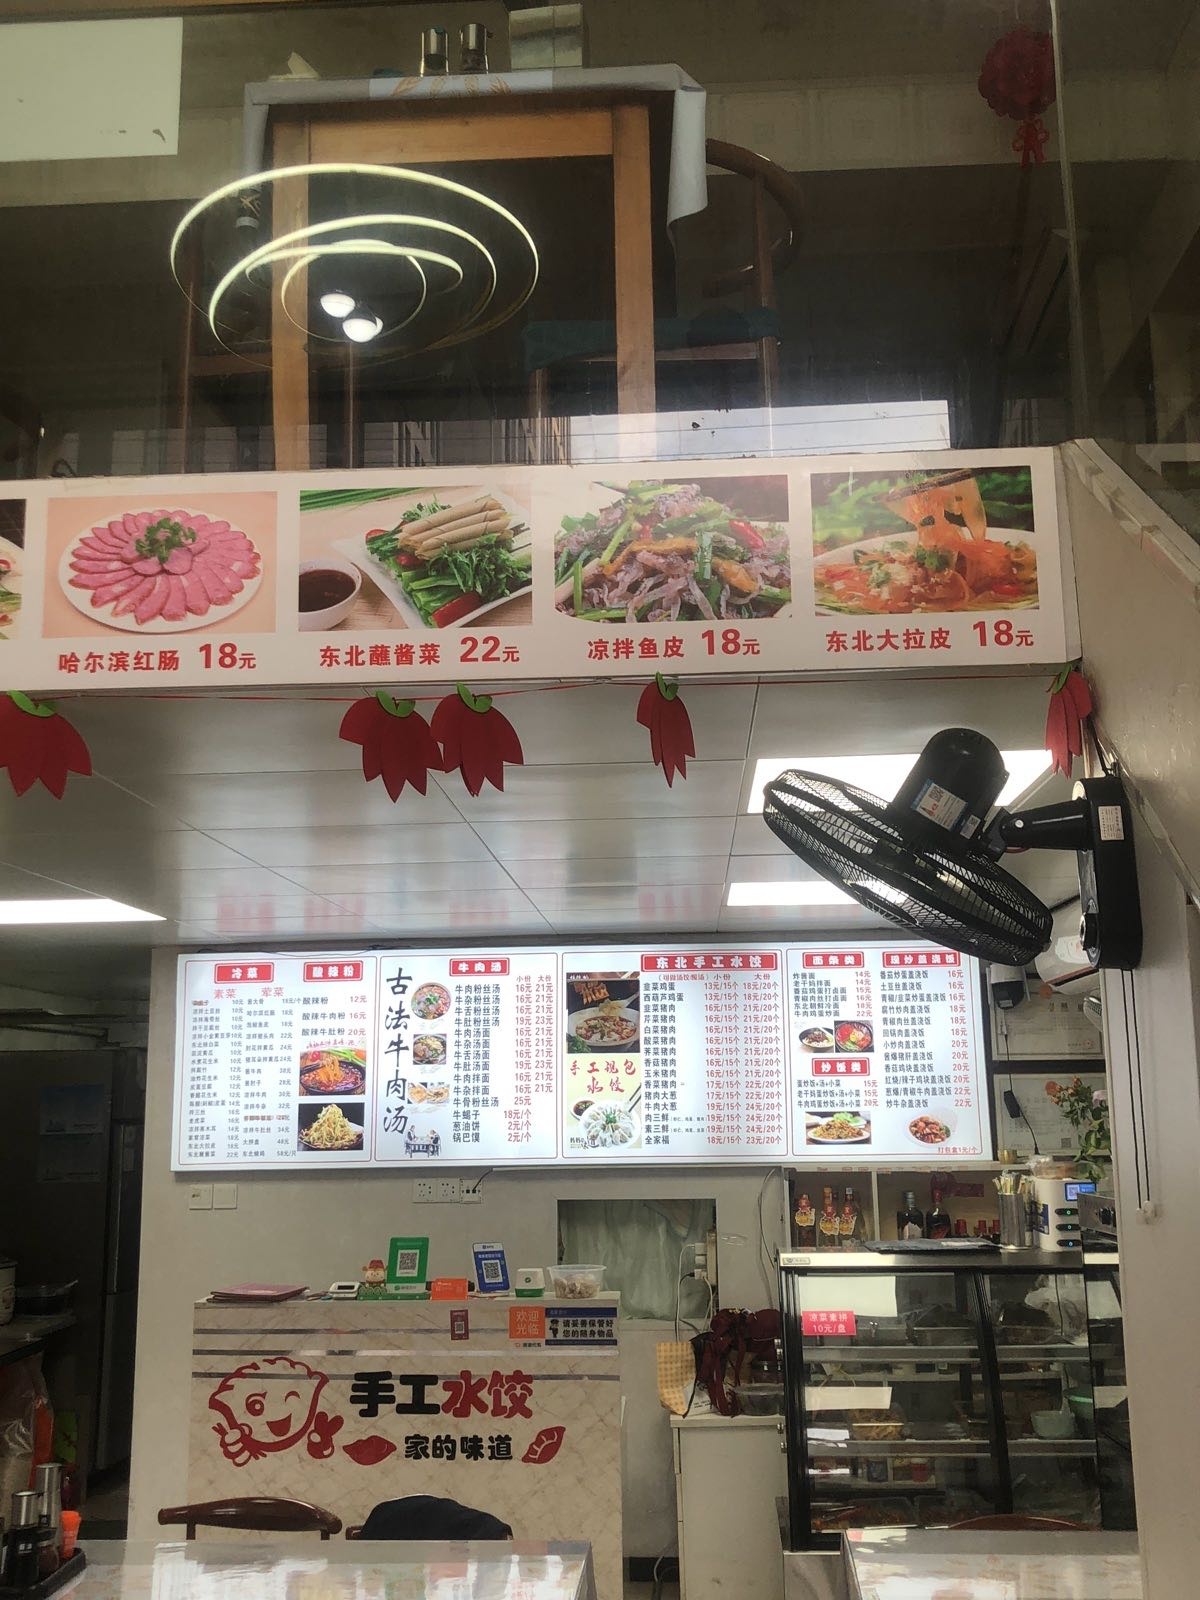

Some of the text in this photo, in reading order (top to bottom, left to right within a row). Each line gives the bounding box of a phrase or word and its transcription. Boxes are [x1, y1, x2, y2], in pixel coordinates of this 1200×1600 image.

[826, 620, 1034, 652] 东北大拉皮 18元
[587, 628, 761, 660] 凉拌鱼皮 18元
[319, 636, 521, 667] 东北蘸酱菜 22元
[58, 642, 256, 674] 哈尔滨红肠 18元
[656, 956, 762, 969] 东北手工水饺
[813, 955, 855, 965] 面条类
[890, 954, 955, 965] 现炒盖浇饭
[312, 966, 354, 978] 酸辣粉
[458, 962, 502, 972] 牛肉汤
[231, 968, 258, 979] 冷菜
[948, 970, 963, 978] 16元
[704, 981, 778, 990] 13元/15个 18元/20个
[856, 978, 871, 986] 14元
[881, 982, 964, 991] 土豆丝盖浇饭 16元
[214, 989, 236, 998] 素菜
[261, 987, 284, 997] 荤菜
[455, 984, 553, 994] 牛肉粉丝汤 16元 21元
[302, 997, 328, 1005] 酸辣粉
[455, 994, 553, 1005] 牛杂粉丝汤 16元 21元
[643, 992, 779, 1002] 西葫芦鸡蛋 13元/15个 18元/20个
[949, 993, 965, 1001] 16元
[455, 1005, 553, 1016] 牛舌粉丝汤 16元 21元
[644, 1003, 779, 1013] 韭菜猪肉 16元/15个 21元/20个
[882, 1005, 966, 1014] 腐竹炒肉盖浇饭 18元
[302, 1012, 366, 1020] 酸辣牛肉粉 16元
[644, 1014, 779, 1023] 芹菜猪肉 16元/15个 21元/20个
[882, 1016, 966, 1026] 青椒肉丝盖浇饭 18元
[455, 1016, 553, 1027] 牛肚粉丝汤 19元 23元
[302, 1028, 366, 1036] 酸辣牛肚粉 20元
[454, 1027, 553, 1038] 牛肉汤面 16元 21元
[644, 1025, 779, 1034] 白菜猪肉 16元/15个 21元/20个
[883, 1028, 967, 1037] 回锅肉盖浇饭 18元
[454, 1038, 553, 1049] 牛杂汤面 16元 21元
[644, 1036, 780, 1045] 酸菜猪肉 16元/15个 21元/20个
[883, 1040, 968, 1049] 小炒肉盖浇饭 20元
[384, 968, 412, 1134] 古法牛肉汤
[454, 1049, 553, 1060] 牛舌汤面 16元 21元
[644, 1047, 780, 1056] 荠菜猪肉 16元/15个 21元/20个
[952, 1052, 968, 1060] 20元
[454, 1060, 553, 1071] 牛肚汤面 19元 23元
[570, 1059, 636, 1076] 手工现包
[644, 1058, 780, 1067] 香菇猪肉 16元/15个 21元/20个
[821, 1062, 861, 1072] 炒饭类
[884, 1063, 969, 1072] 香菇鸡块盖浇饭 20元
[454, 1072, 553, 1083] 牛肉拌面 16元 21元
[644, 1069, 781, 1078] 玉米猪肉 16元/15个 21元/20个
[953, 1075, 970, 1083] 20元
[454, 1084, 553, 1095] 牛杂拌面 16元 21元
[587, 1076, 625, 1094] 水饺
[644, 1080, 781, 1089] 香菜猪肉 17元/15个 22元/20个
[644, 1091, 782, 1100] 猪肉大葱 17元/15个 22元/20个
[954, 1087, 971, 1095] 22元
[453, 1097, 531, 1107] 牛骨粉丝汤 25元
[644, 1102, 782, 1111] 牛肉大葱 19元/15个 24元/20个
[886, 1098, 971, 1108] 炒牛杂盖浇饭 22元
[453, 1109, 532, 1120] 牛蝎子 18元/个
[645, 1113, 669, 1122] 肉三鲜
[707, 1113, 742, 1122] 19元/15个
[746, 1113, 782, 1122] 24元/20个
[453, 1121, 532, 1132] 葱油饼 2元/个
[645, 1124, 669, 1134] 素三鲜
[707, 1124, 742, 1134] 19元/15个
[746, 1124, 783, 1133] 24元/20个
[508, 1132, 532, 1142] 2元/个
[645, 1135, 783, 1145] 全家福 18元/15个 23元/20个
[516, 1310, 539, 1322] 欢迎
[562, 1319, 614, 1328] 请妥善保管好
[813, 1324, 846, 1333] 10元/盘
[516, 1323, 539, 1335] 光临
[562, 1329, 614, 1338] 您的随身物品
[349, 1369, 533, 1418] 手工水饺
[404, 1434, 513, 1461] 家的味道
